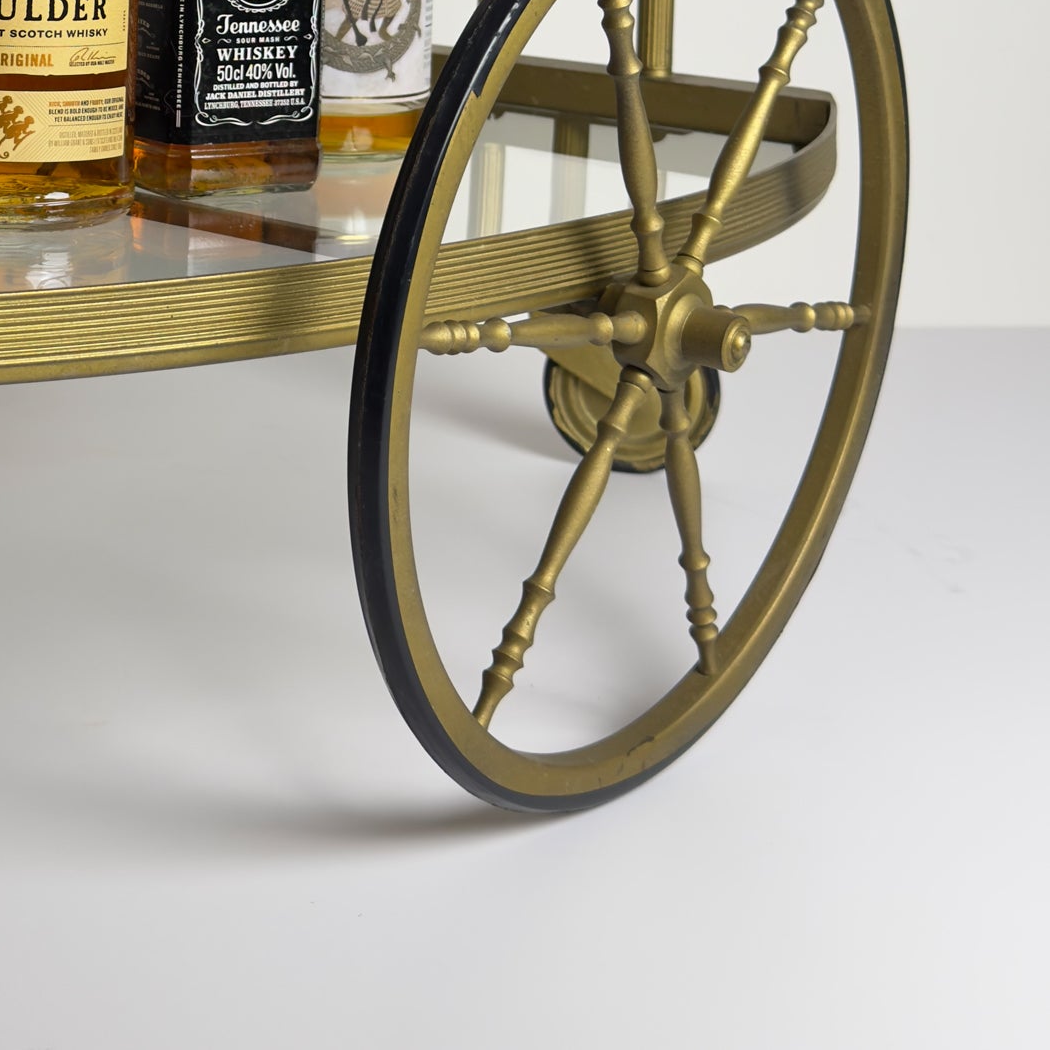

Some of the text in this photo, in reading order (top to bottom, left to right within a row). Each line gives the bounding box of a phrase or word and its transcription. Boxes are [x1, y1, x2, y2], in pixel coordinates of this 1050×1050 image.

[179, 4, 185, 12] IN
[216, 14, 300, 35] Tennessee
[10, 29, 62, 38] SCOTCH
[67, 28, 108, 38] WHISKY
[217, 45, 298, 61] WHISKEY
[217, 62, 296, 82] 50cl 40% Vol.
[213, 82, 245, 91] DISTILLED
[260, 81, 289, 89] BOTTLED
[290, 80, 299, 88] BY
[205, 88, 306, 101] JACK DANIEL DISTILLERY
[204, 101, 240, 110] LYNCHBURG,
[240, 99, 273, 109] TENNESSEE
